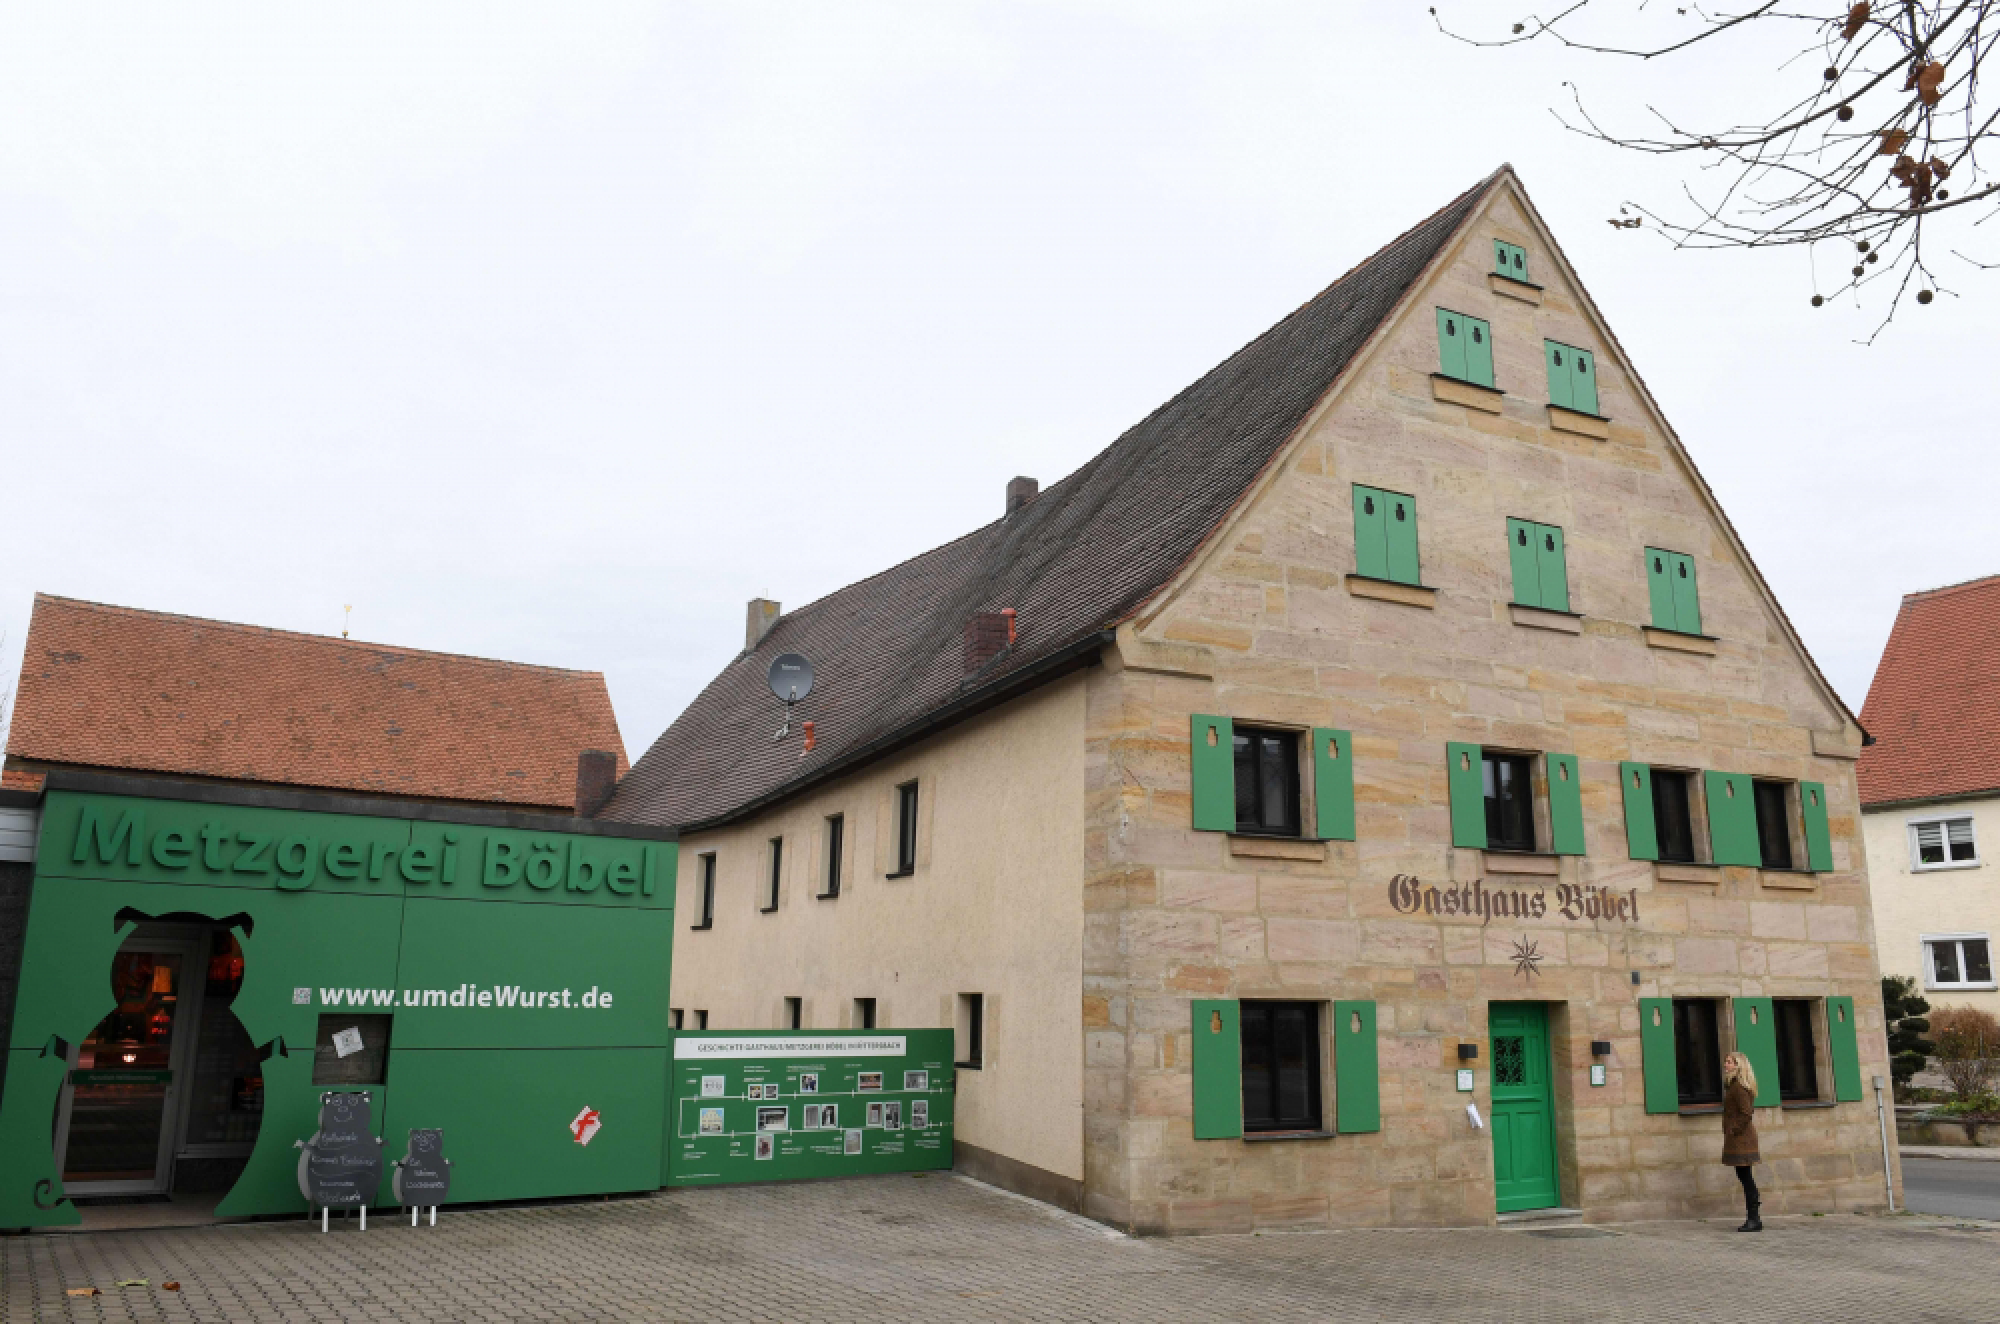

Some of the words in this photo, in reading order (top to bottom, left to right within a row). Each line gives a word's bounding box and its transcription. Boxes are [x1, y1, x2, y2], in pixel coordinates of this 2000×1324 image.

[72, 806, 458, 889] Metzgerei
[483, 837, 656, 896] Böbel
[1388, 874, 1547, 927] Gasthaus
[1556, 883, 1639, 922] Böbel
[319, 984, 613, 1008] www.umdieWurst.de
